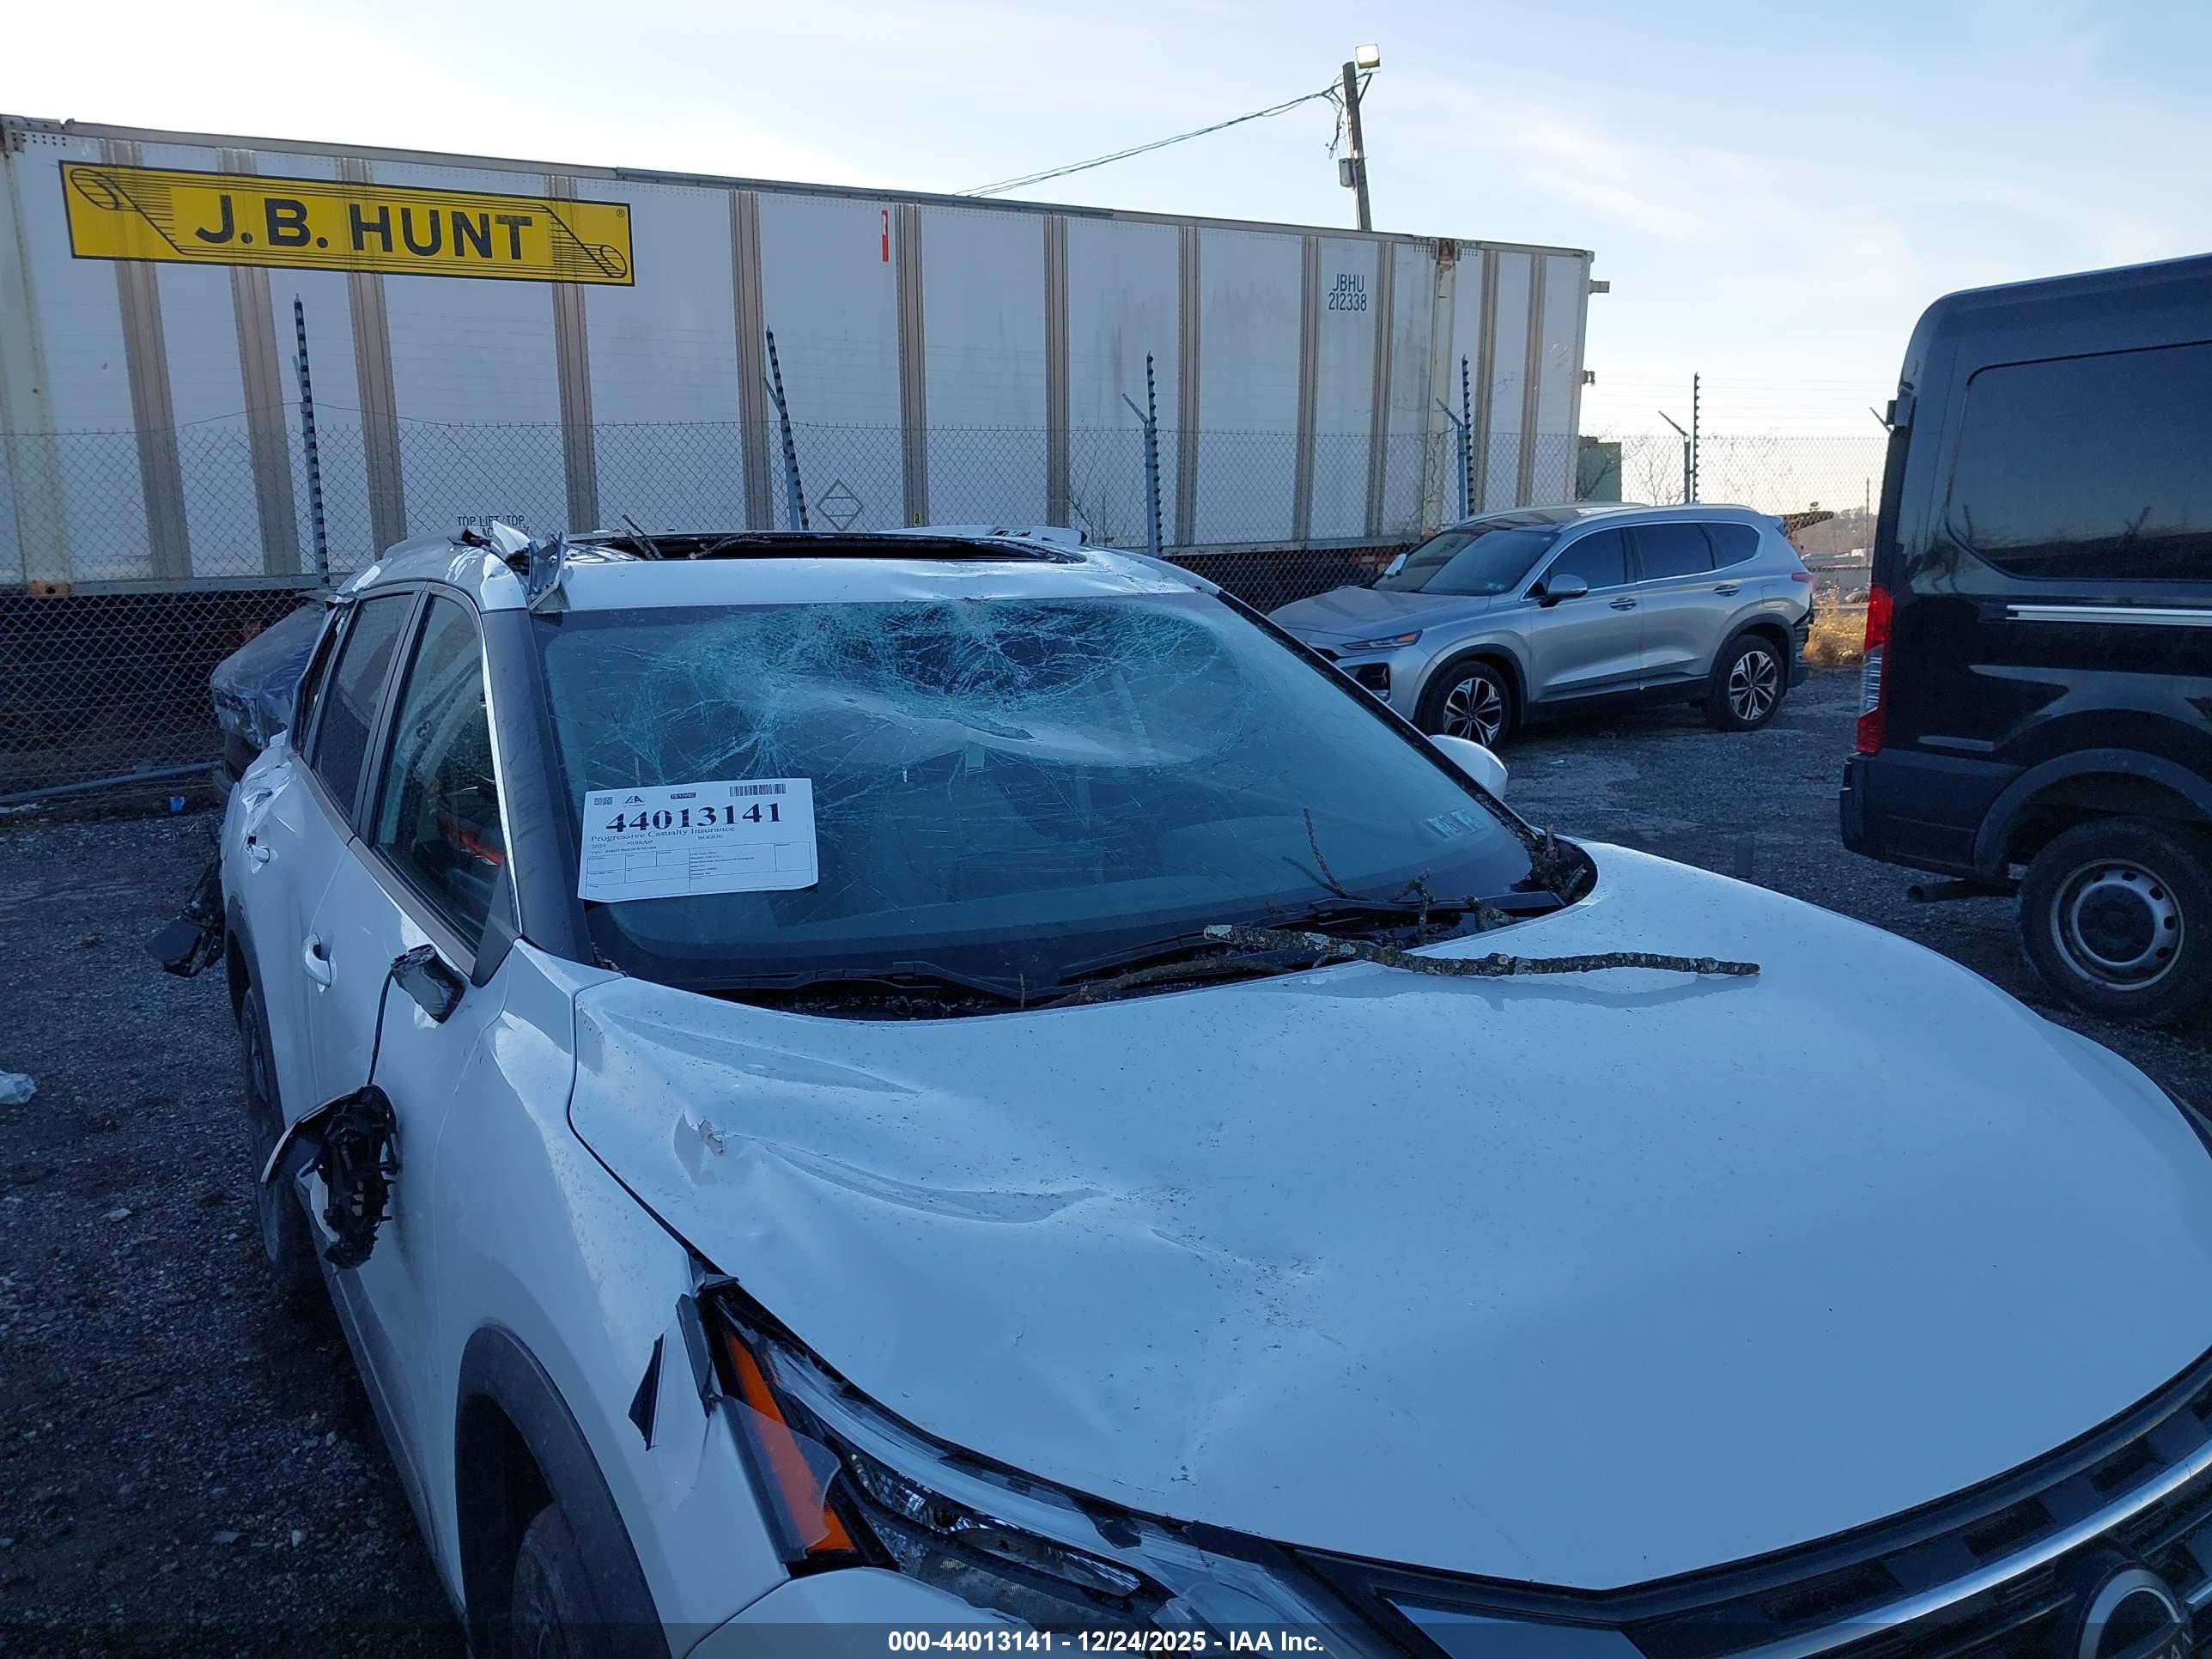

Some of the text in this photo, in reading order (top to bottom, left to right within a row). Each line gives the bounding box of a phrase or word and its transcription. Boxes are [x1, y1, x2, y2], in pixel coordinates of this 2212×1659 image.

[349, 204, 533, 261] HUNT
[1333, 274, 1364, 292] JBHU
[1328, 292, 1367, 311] 212338
[457, 516, 476, 526] TOP
[605, 801, 784, 833] 44013141
[591, 833, 646, 842] Progressive
[647, 829, 688, 837] Casualty
